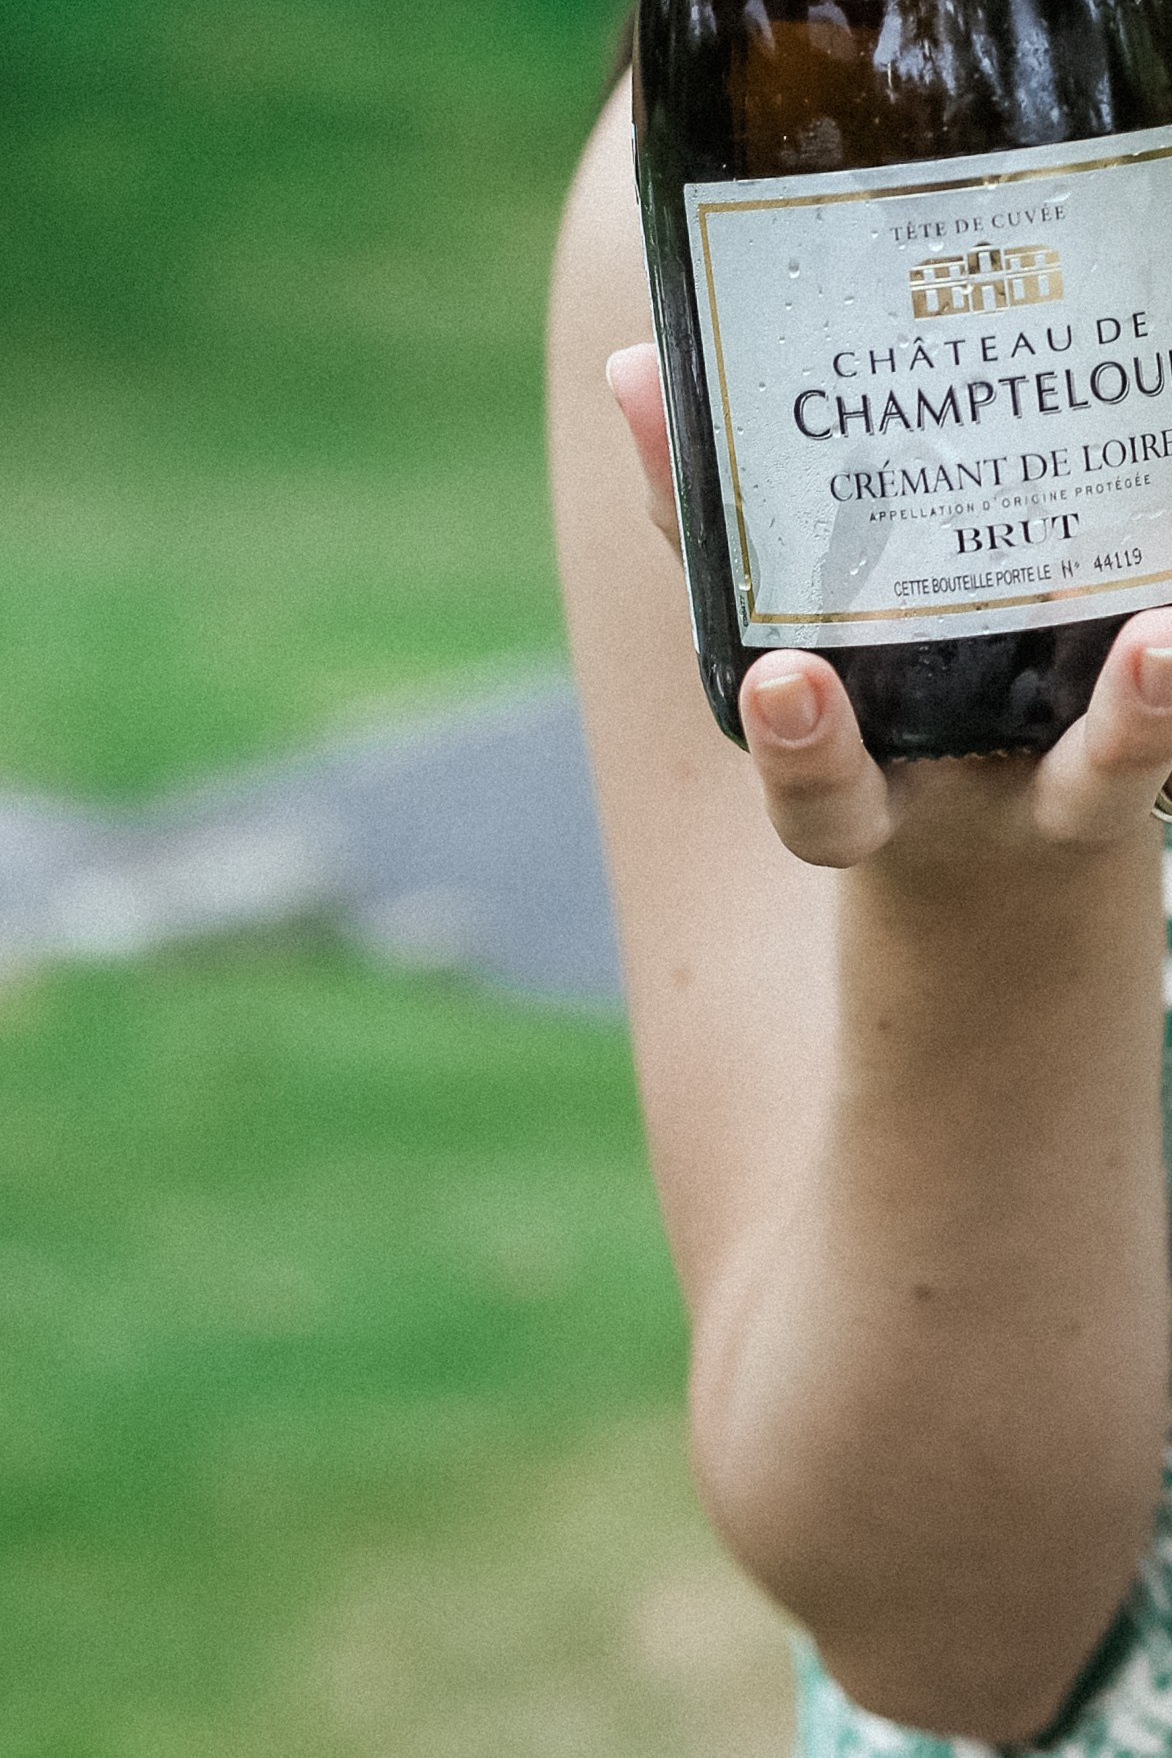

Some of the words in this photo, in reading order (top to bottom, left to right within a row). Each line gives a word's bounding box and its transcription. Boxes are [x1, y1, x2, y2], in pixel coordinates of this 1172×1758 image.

[889, 220, 948, 242] TÊTE
[955, 217, 985, 234] DE
[991, 202, 1067, 229] CUVÉE
[832, 326, 1074, 378] CHÂTEAU
[1096, 311, 1149, 345] DE
[829, 456, 1008, 502] CRÉMANT
[1020, 448, 1071, 483] DE
[869, 502, 976, 523] APPELLATION
[982, 489, 1068, 512] D'ORIGINE
[1075, 473, 1152, 497] PROTÉGÉE
[953, 513, 1080, 555] BRUT
[893, 578, 930, 598] CETTE
[932, 571, 995, 593] BOUTEILLE
[996, 566, 1035, 586] PORTE
[1037, 564, 1052, 581] LE
[1093, 547, 1143, 573] 44119
